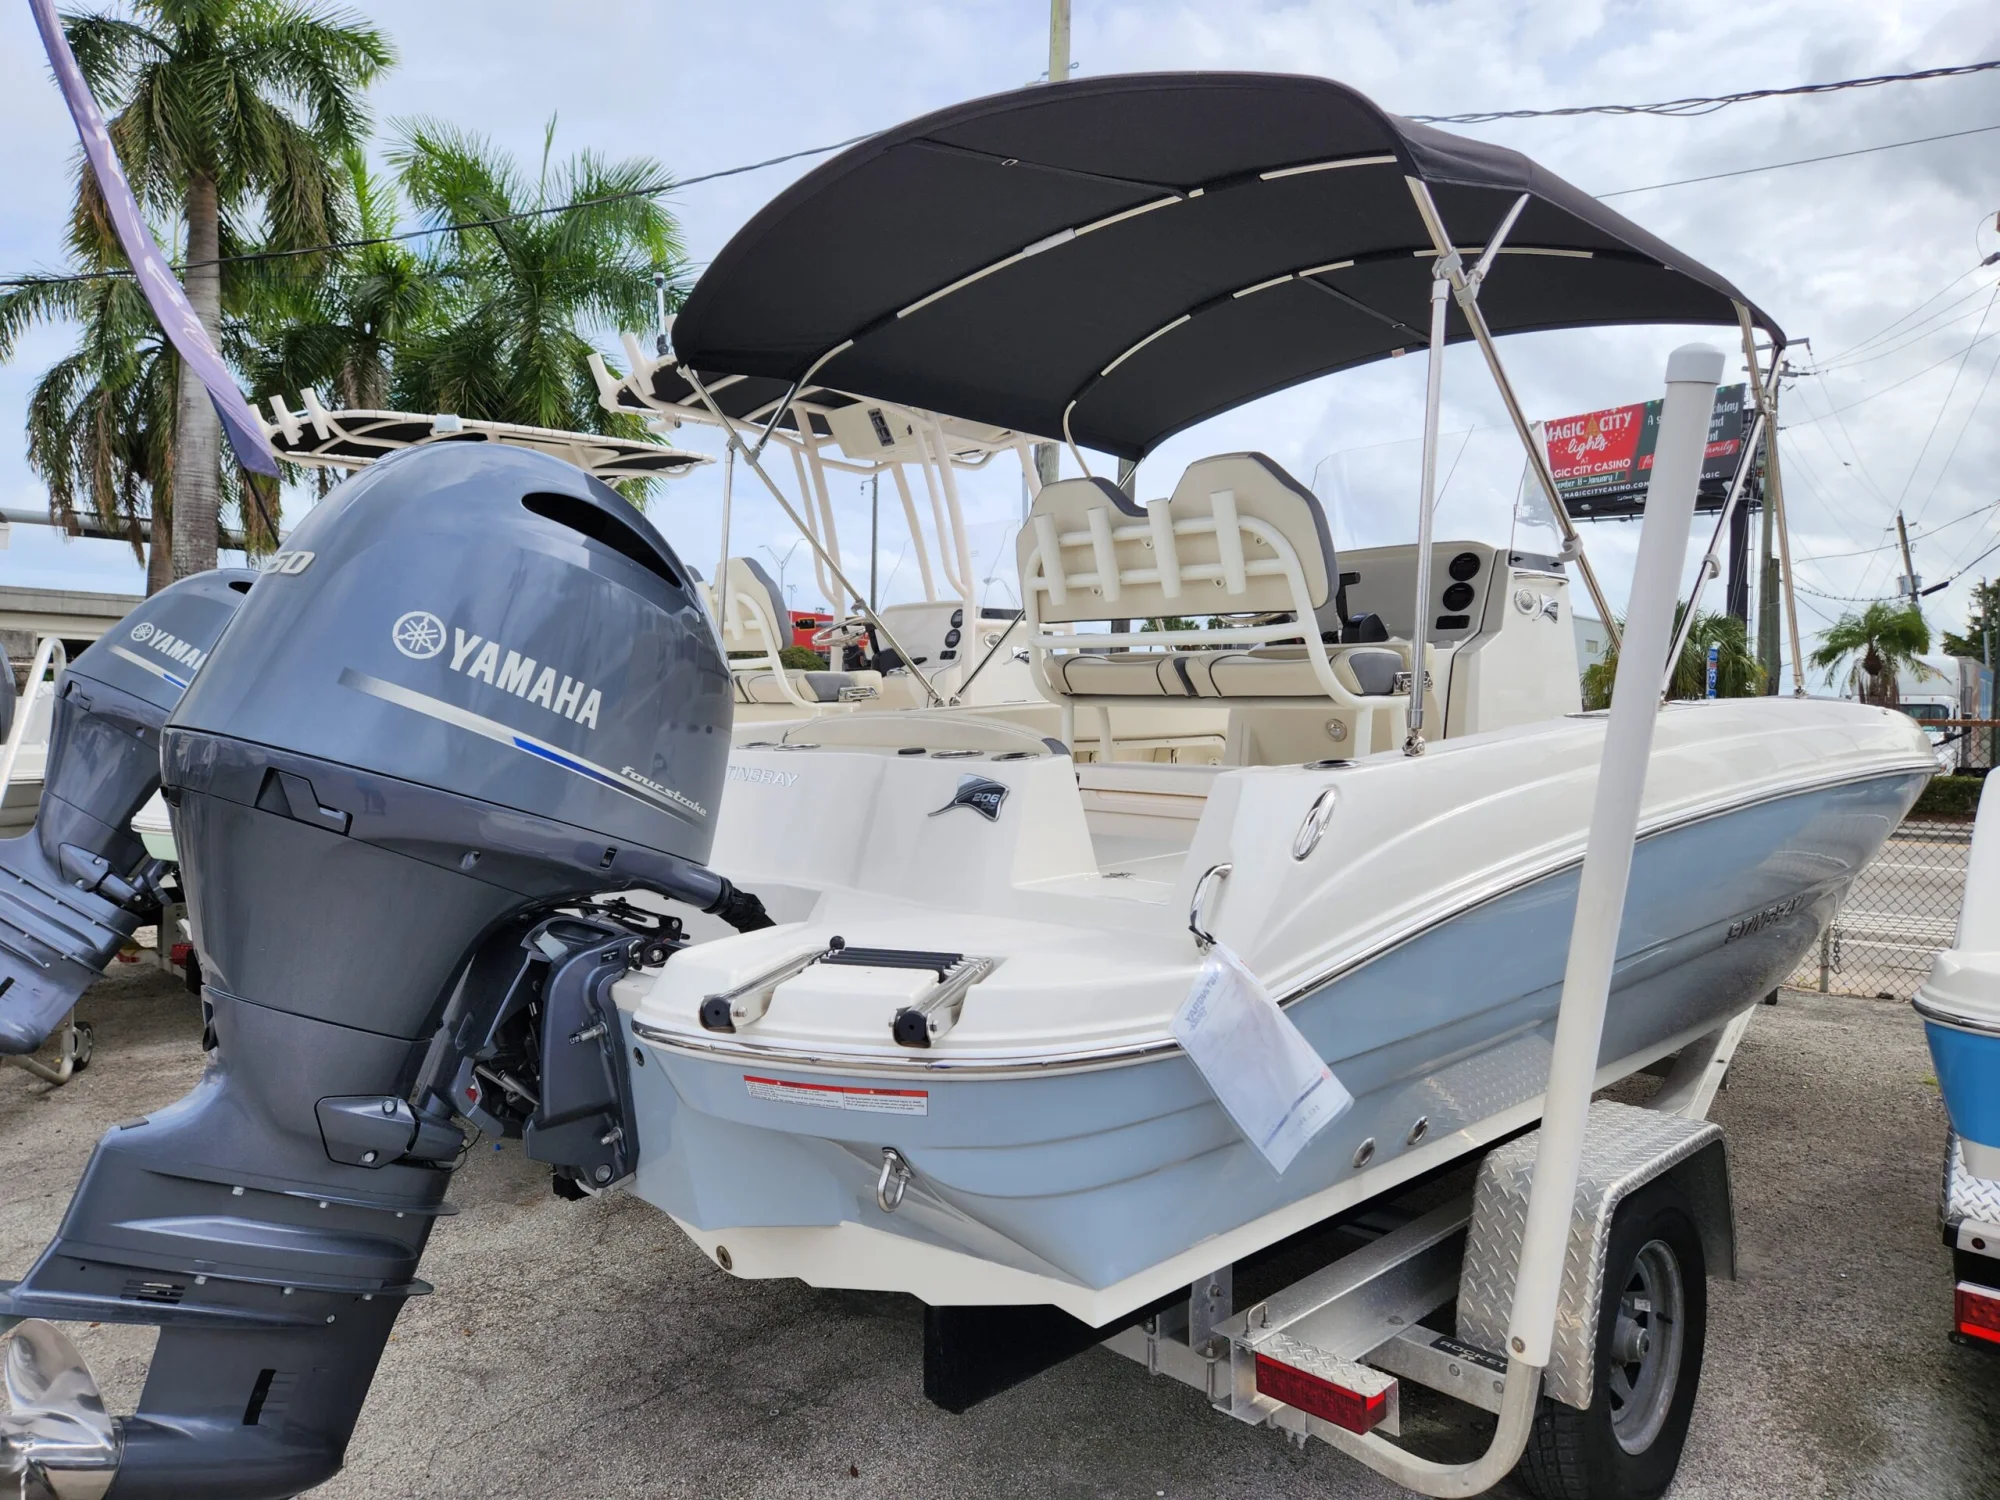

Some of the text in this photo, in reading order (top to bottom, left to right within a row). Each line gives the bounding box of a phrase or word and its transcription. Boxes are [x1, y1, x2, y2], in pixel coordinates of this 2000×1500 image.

[1647, 414, 1654, 426] A
[1712, 401, 1740, 415] oliday
[1546, 421, 1585, 442] MAGIC
[1599, 411, 1632, 432] CITY
[1567, 434, 1608, 460] lights
[1550, 458, 1631, 479] AGIC CITY CASINO
[1701, 471, 1720, 479] AGIC
[148, 629, 208, 671] YAMA
[449, 627, 602, 730] YAMAHA
[728, 765, 800, 788] TINGRAY
[620, 765, 707, 817] fourstroke
[972, 792, 1001, 803] 206
[1440, 1340, 1507, 1368] ROCKET
